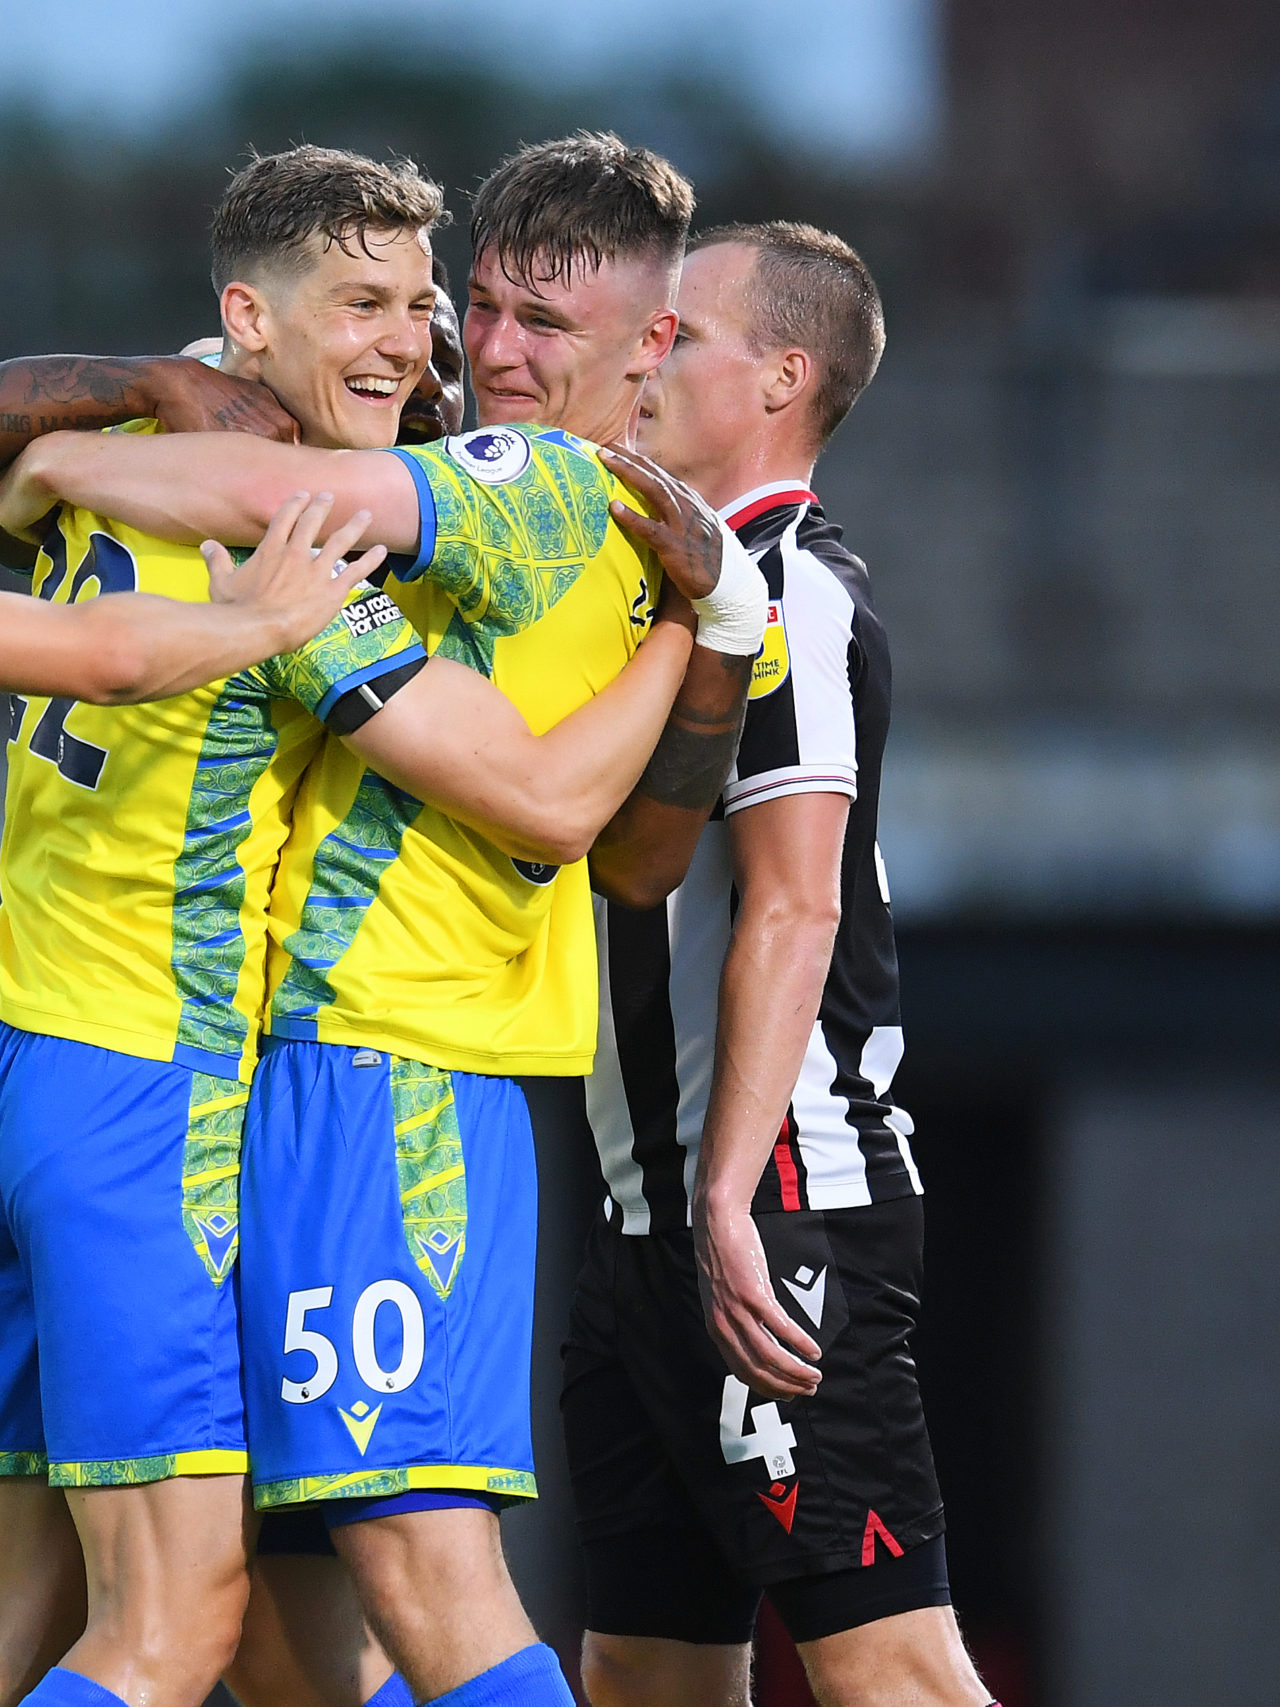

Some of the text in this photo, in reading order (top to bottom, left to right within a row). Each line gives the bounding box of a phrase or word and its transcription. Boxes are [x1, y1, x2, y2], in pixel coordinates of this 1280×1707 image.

[340, 603, 368, 625] No
[349, 615, 373, 638] for
[755, 659, 780, 670] TIME
[280, 1278, 426, 1405] 50
[719, 1373, 798, 1481] 4
[776, 1468, 789, 1477] EFL
